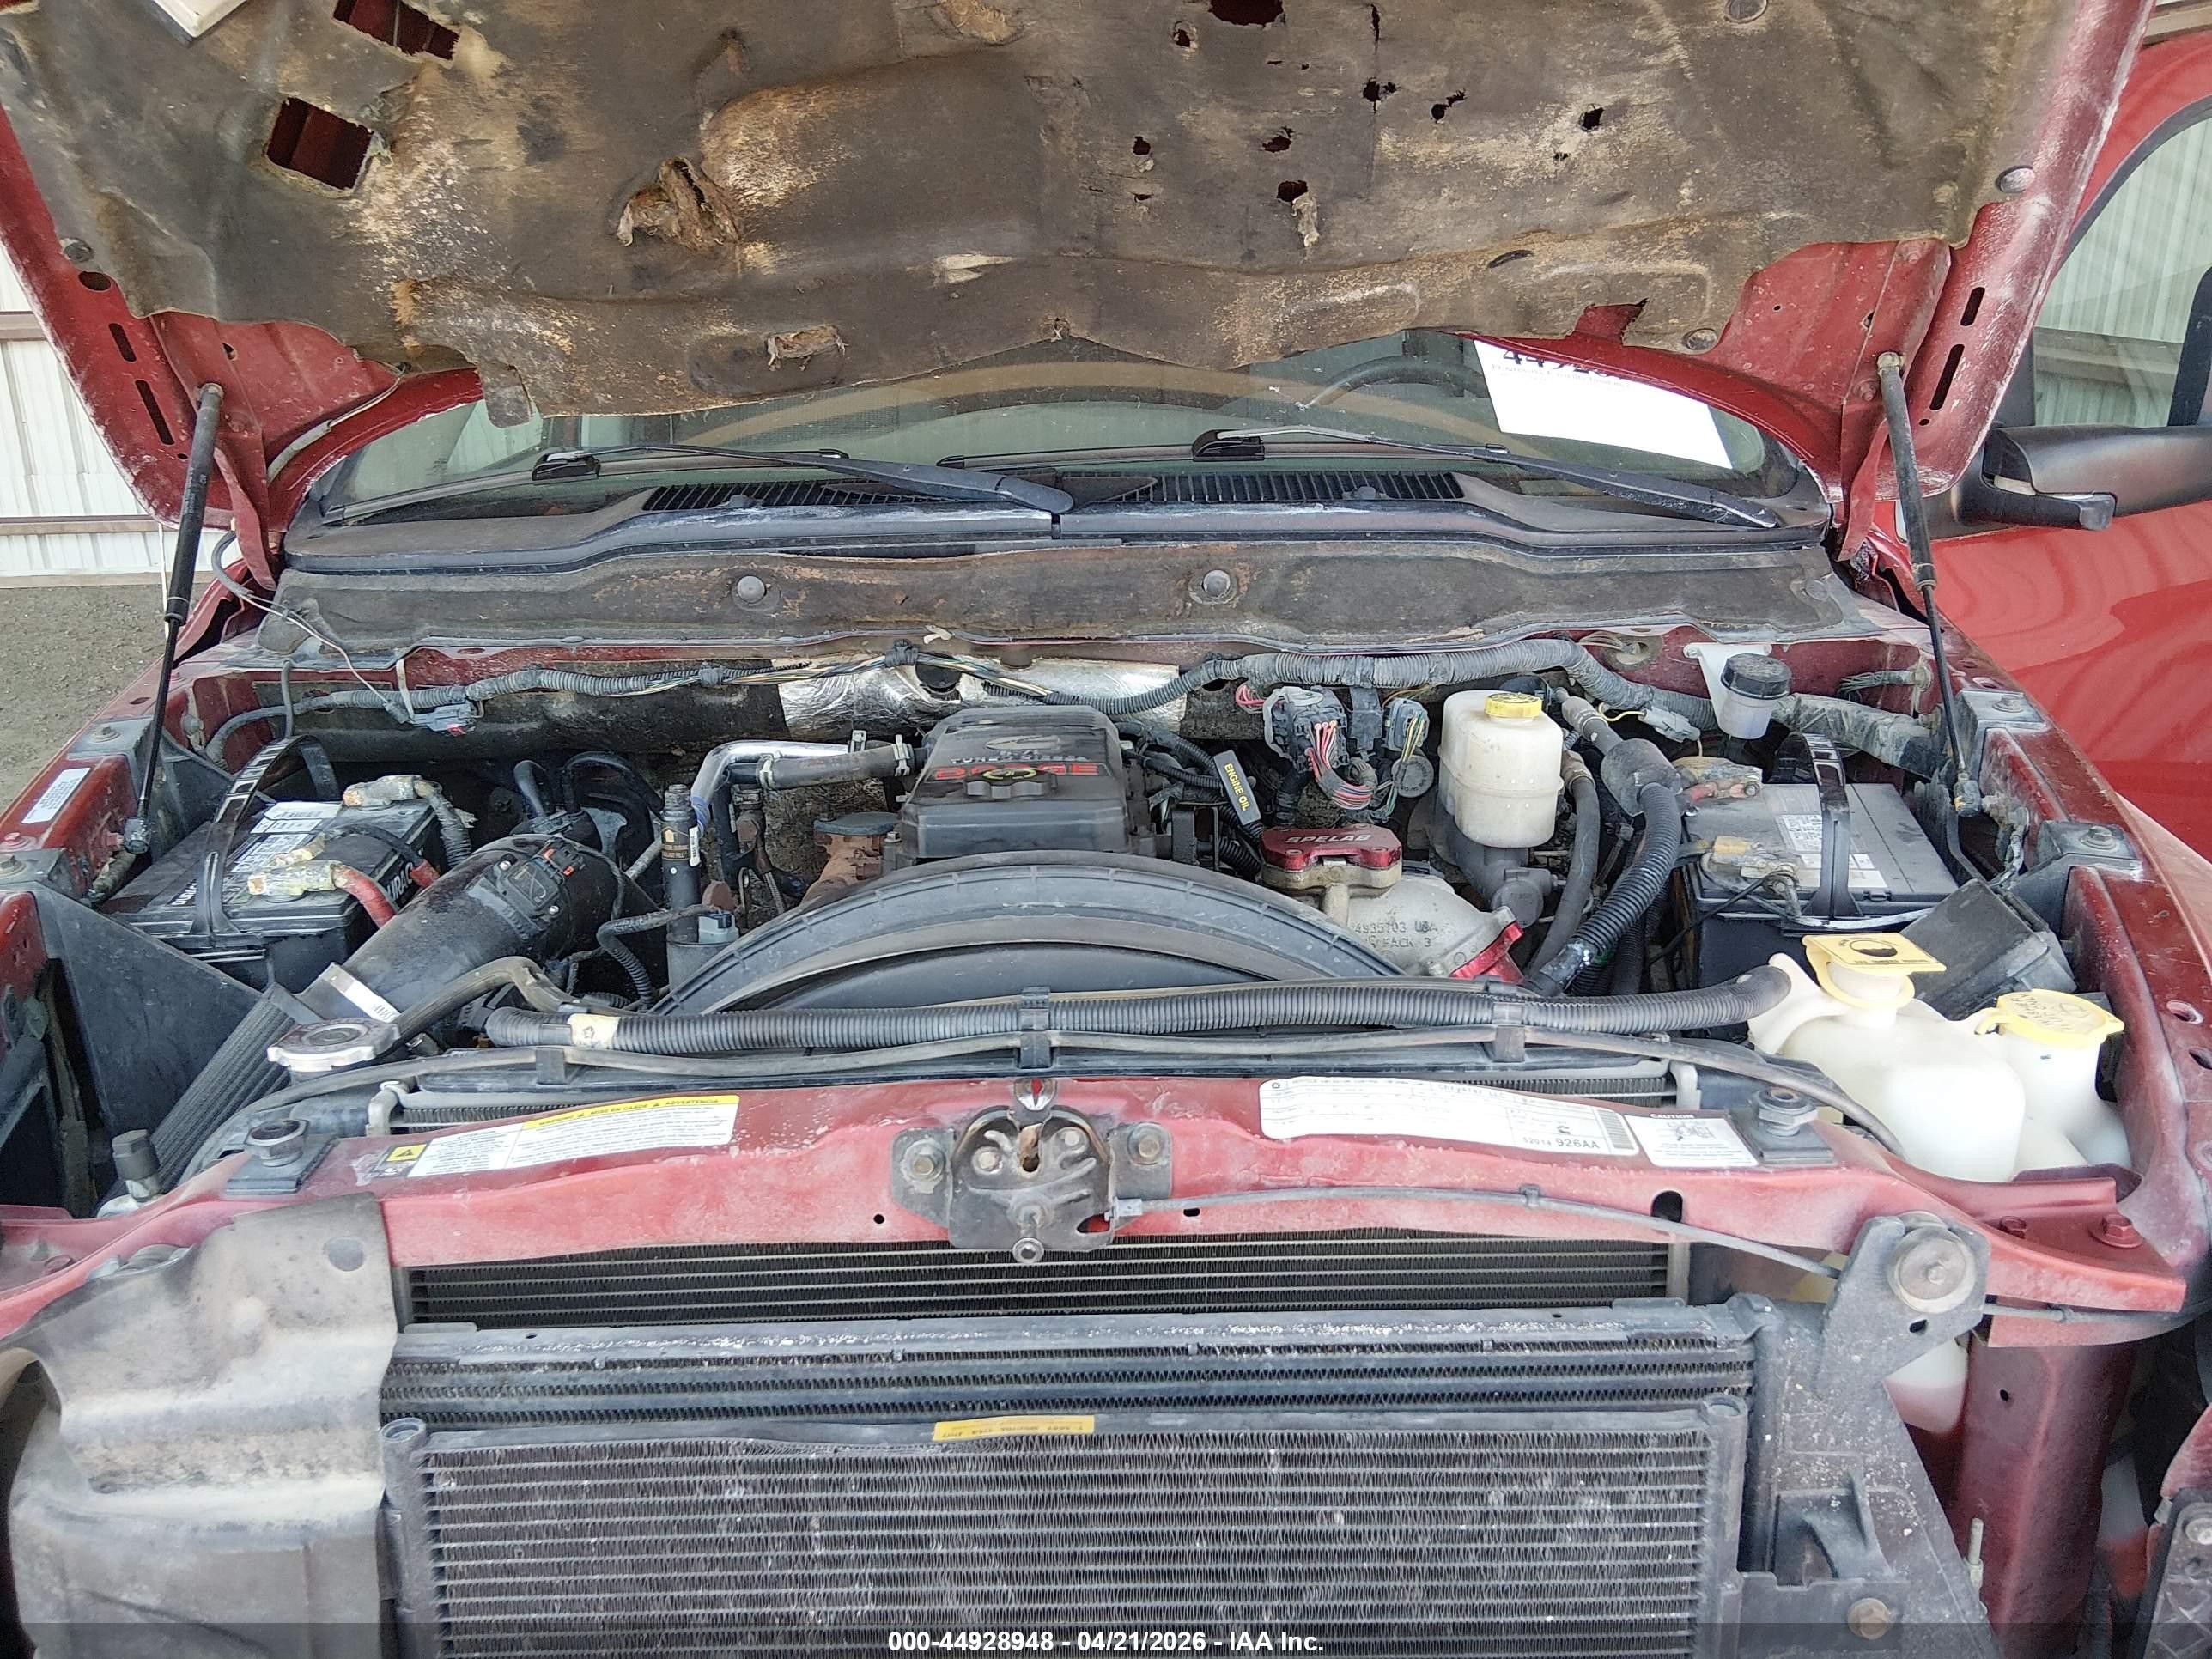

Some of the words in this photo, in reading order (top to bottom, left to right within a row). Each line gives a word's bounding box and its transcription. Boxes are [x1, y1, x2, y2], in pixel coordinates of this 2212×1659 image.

[1224, 763, 1244, 796] ENGINE
[1237, 794, 1251, 811] OIL
[1555, 1137, 1601, 1149] 926AA
